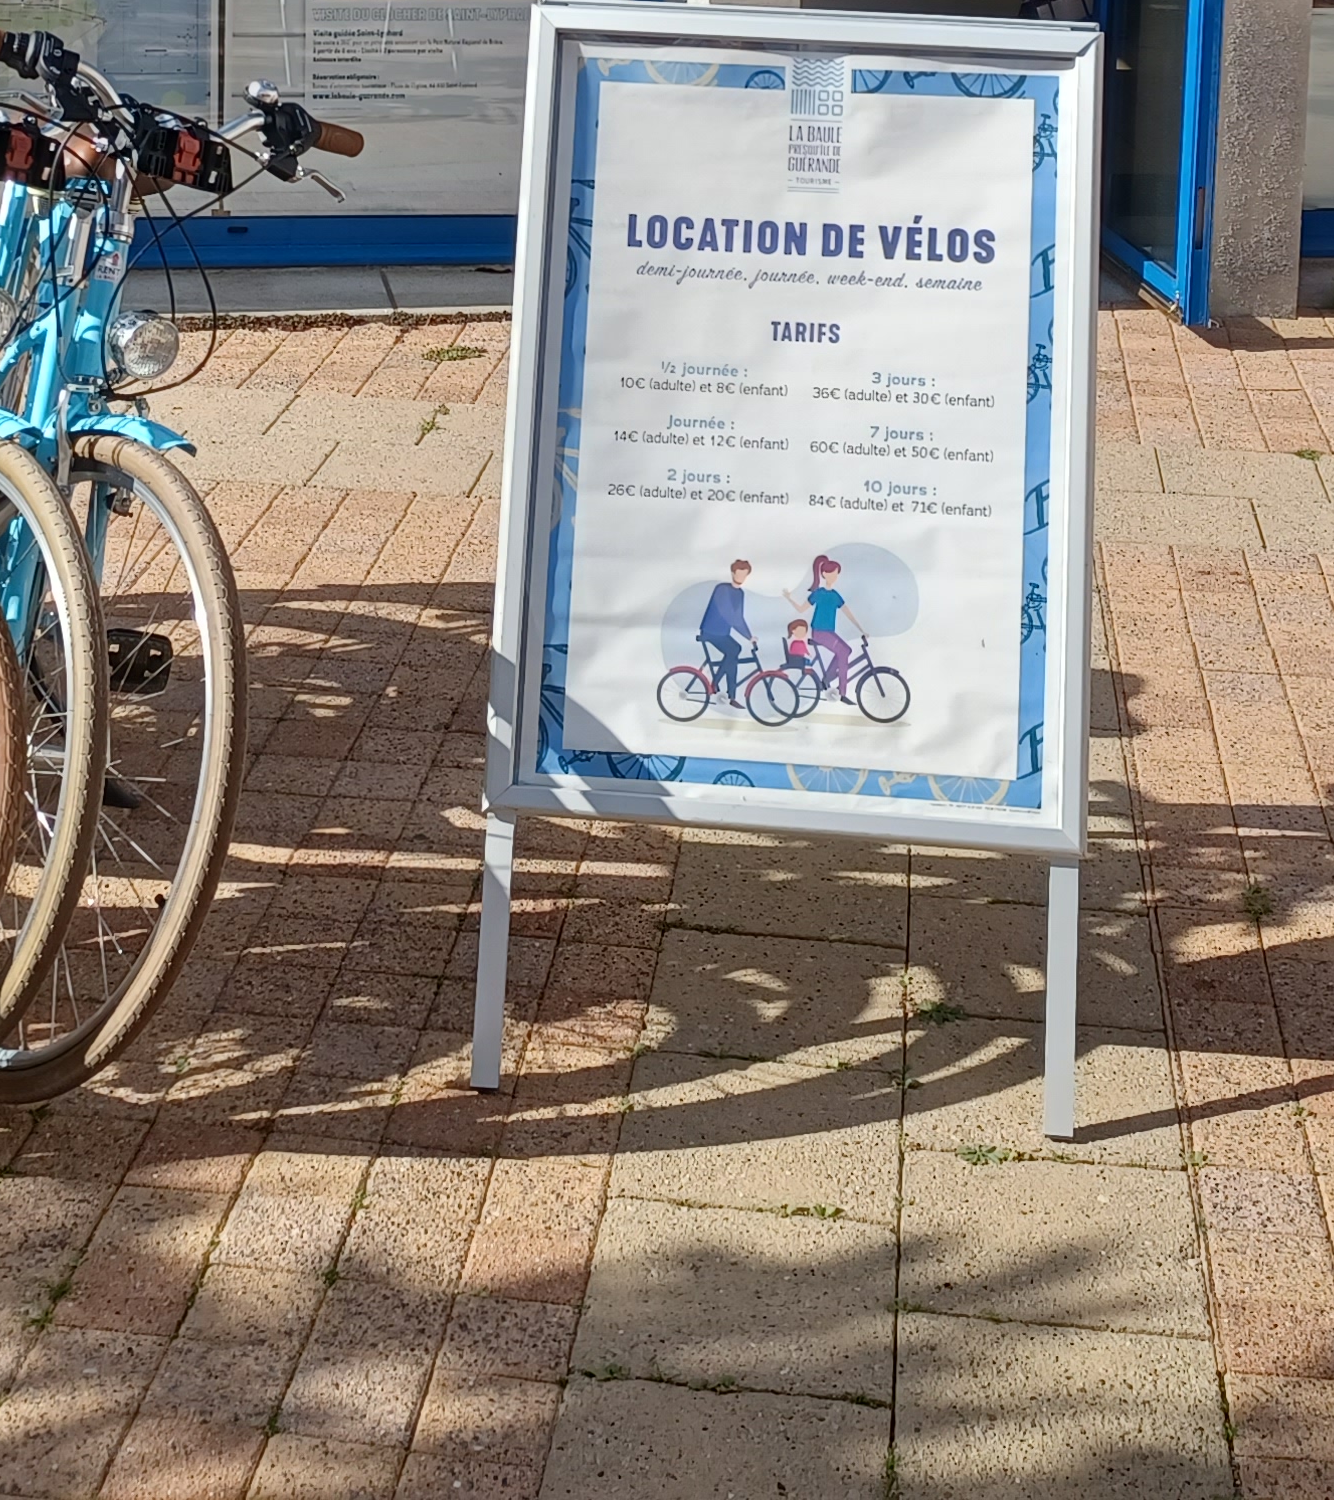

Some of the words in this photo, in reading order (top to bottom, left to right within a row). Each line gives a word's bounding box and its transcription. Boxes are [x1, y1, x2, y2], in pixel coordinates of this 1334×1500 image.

[313, 8, 351, 21] VISITE
[353, 8, 369, 21] DU
[428, 8, 444, 21] DE
[357, 29, 403, 38] Saint-Lyhard
[789, 125, 803, 142] LA
[807, 126, 842, 143] BAULE
[832, 146, 841, 156] DE
[788, 155, 841, 174] GUÉRANDE
[796, 177, 832, 185] TOURISME
[627, 214, 808, 256] LOCATION
[822, 223, 865, 258] DE
[878, 215, 996, 264] VÉLOS
[98, 265, 121, 276] RENT
[916, 277, 983, 291] semaine
[771, 321, 841, 344] TARIFS
[681, 362, 739, 377] journée
[620, 377, 645, 389] 10€
[649, 378, 696, 392] (adulte)
[700, 382, 712, 393] et
[716, 382, 735, 394] 8€
[739, 382, 788, 397] (enfant)
[872, 371, 881, 384] 3
[886, 373, 926, 388] jours
[813, 387, 840, 399] 36€
[844, 388, 892, 403] (adulte)
[896, 392, 908, 403] et
[945, 393, 995, 408] (enfant)
[667, 415, 725, 430] Journée
[614, 430, 638, 443] 14€
[642, 431, 689, 445] (adulte)
[693, 435, 705, 446] et
[711, 435, 736, 448] 12€
[740, 436, 789, 450] (enfant)
[870, 426, 879, 438] 7
[884, 426, 924, 441] jours
[810, 441, 839, 454] 60€
[843, 442, 890, 457] (adulte)
[894, 446, 907, 457] et
[911, 446, 939, 460] 50€
[944, 448, 994, 462] (enfant)
[667, 469, 677, 481] 2
[681, 469, 721, 485] jours
[608, 484, 636, 497] 26€
[639, 485, 687, 500] (adulte)
[690, 489, 703, 500] et
[707, 489, 736, 502] 20€
[739, 490, 789, 505] (enfant)
[864, 480, 882, 493] 10
[887, 481, 927, 497] jours
[809, 494, 836, 508] 84€
[840, 496, 887, 511] (adulte)
[892, 501, 904, 512] et
[911, 501, 938, 514] 71€
[942, 502, 992, 517] (enfant)
